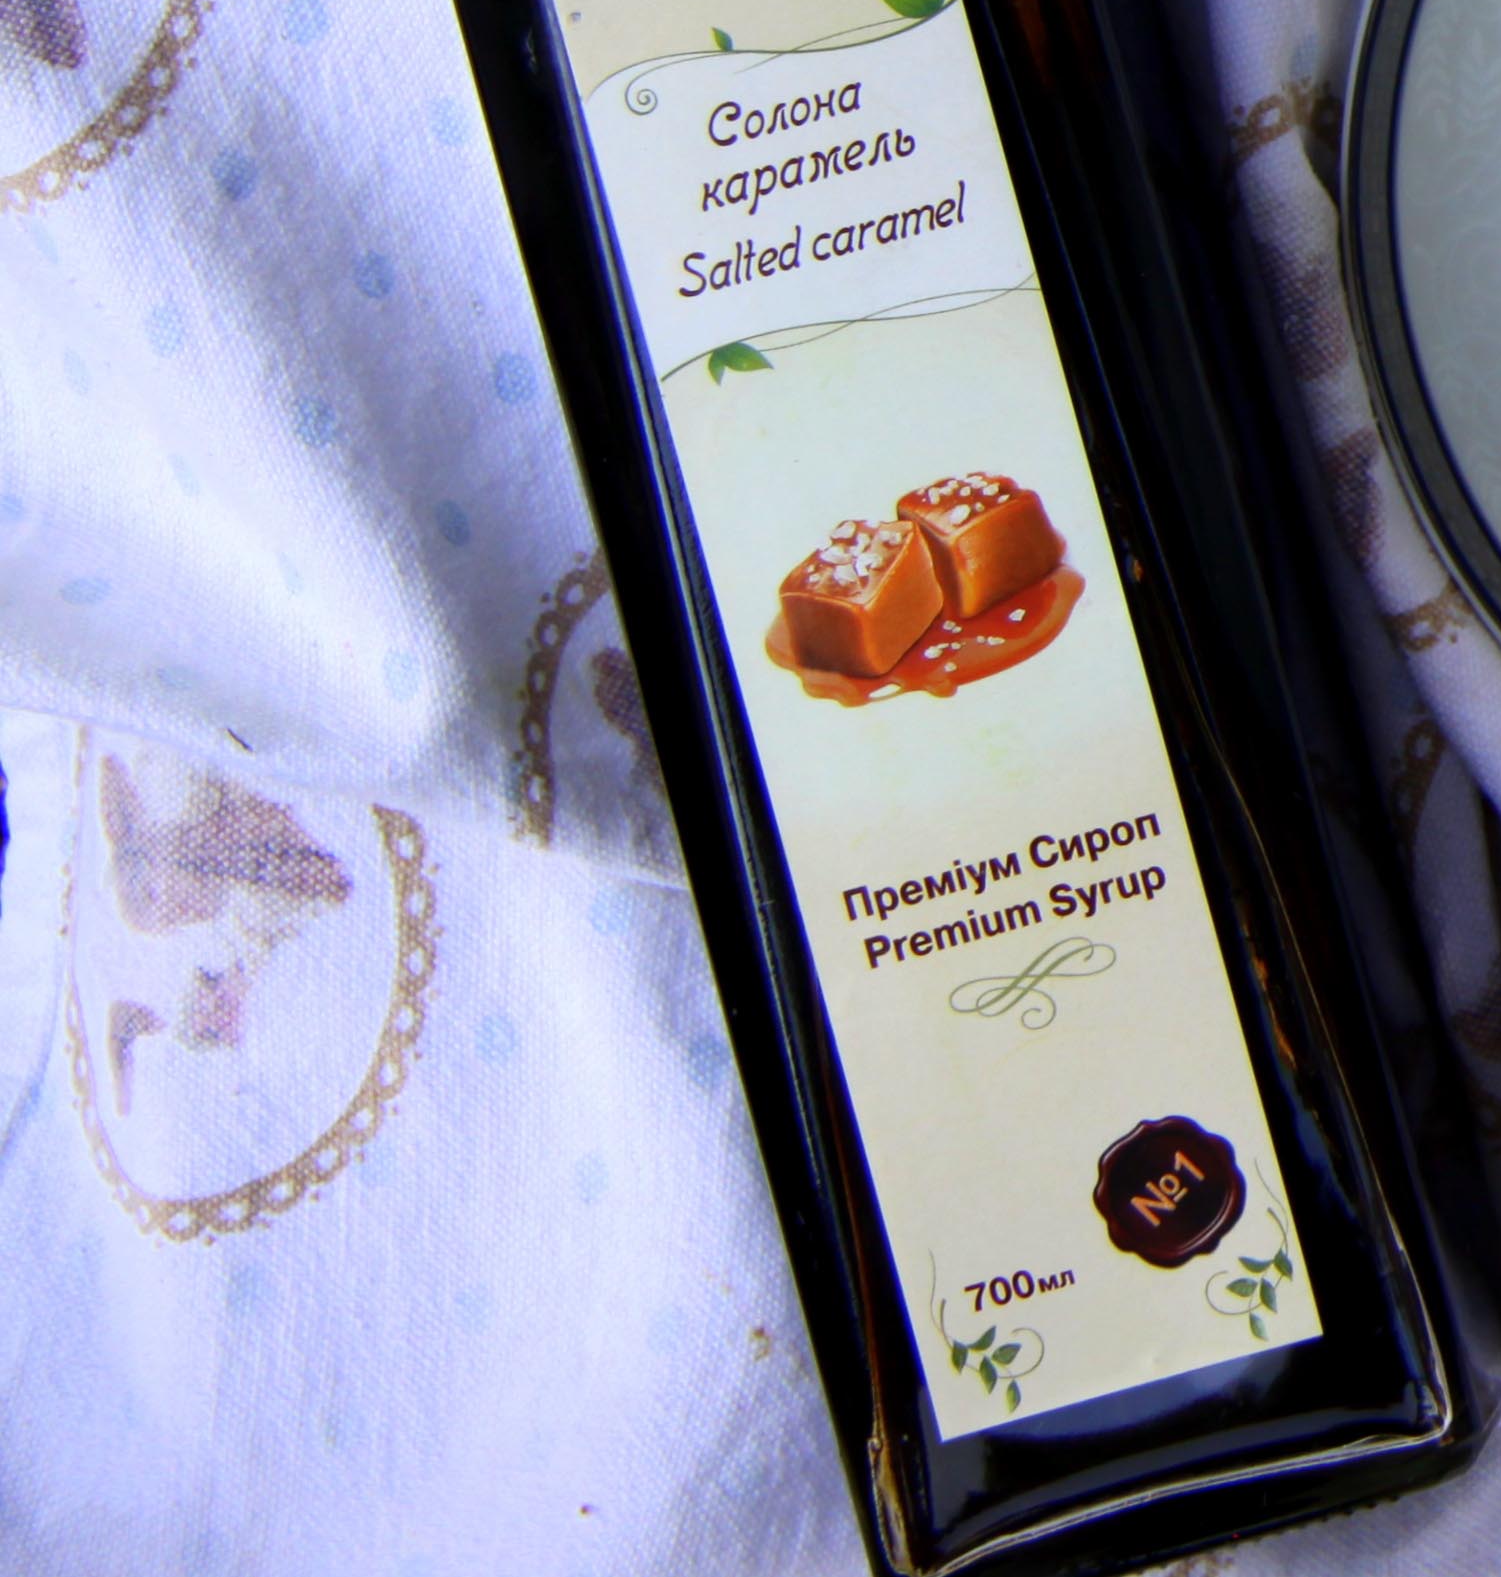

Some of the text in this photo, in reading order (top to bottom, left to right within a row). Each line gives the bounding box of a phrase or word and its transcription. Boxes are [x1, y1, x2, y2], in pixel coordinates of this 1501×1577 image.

[707, 81, 862, 147] Солона
[701, 128, 916, 215] карамель
[678, 179, 966, 297] Salted caramel
[842, 812, 1162, 921] Преміум Сироп
[863, 864, 1167, 969] Premium Syrup
[1130, 1150, 1205, 1226] №1
[963, 1269, 1076, 1312] 700мл
